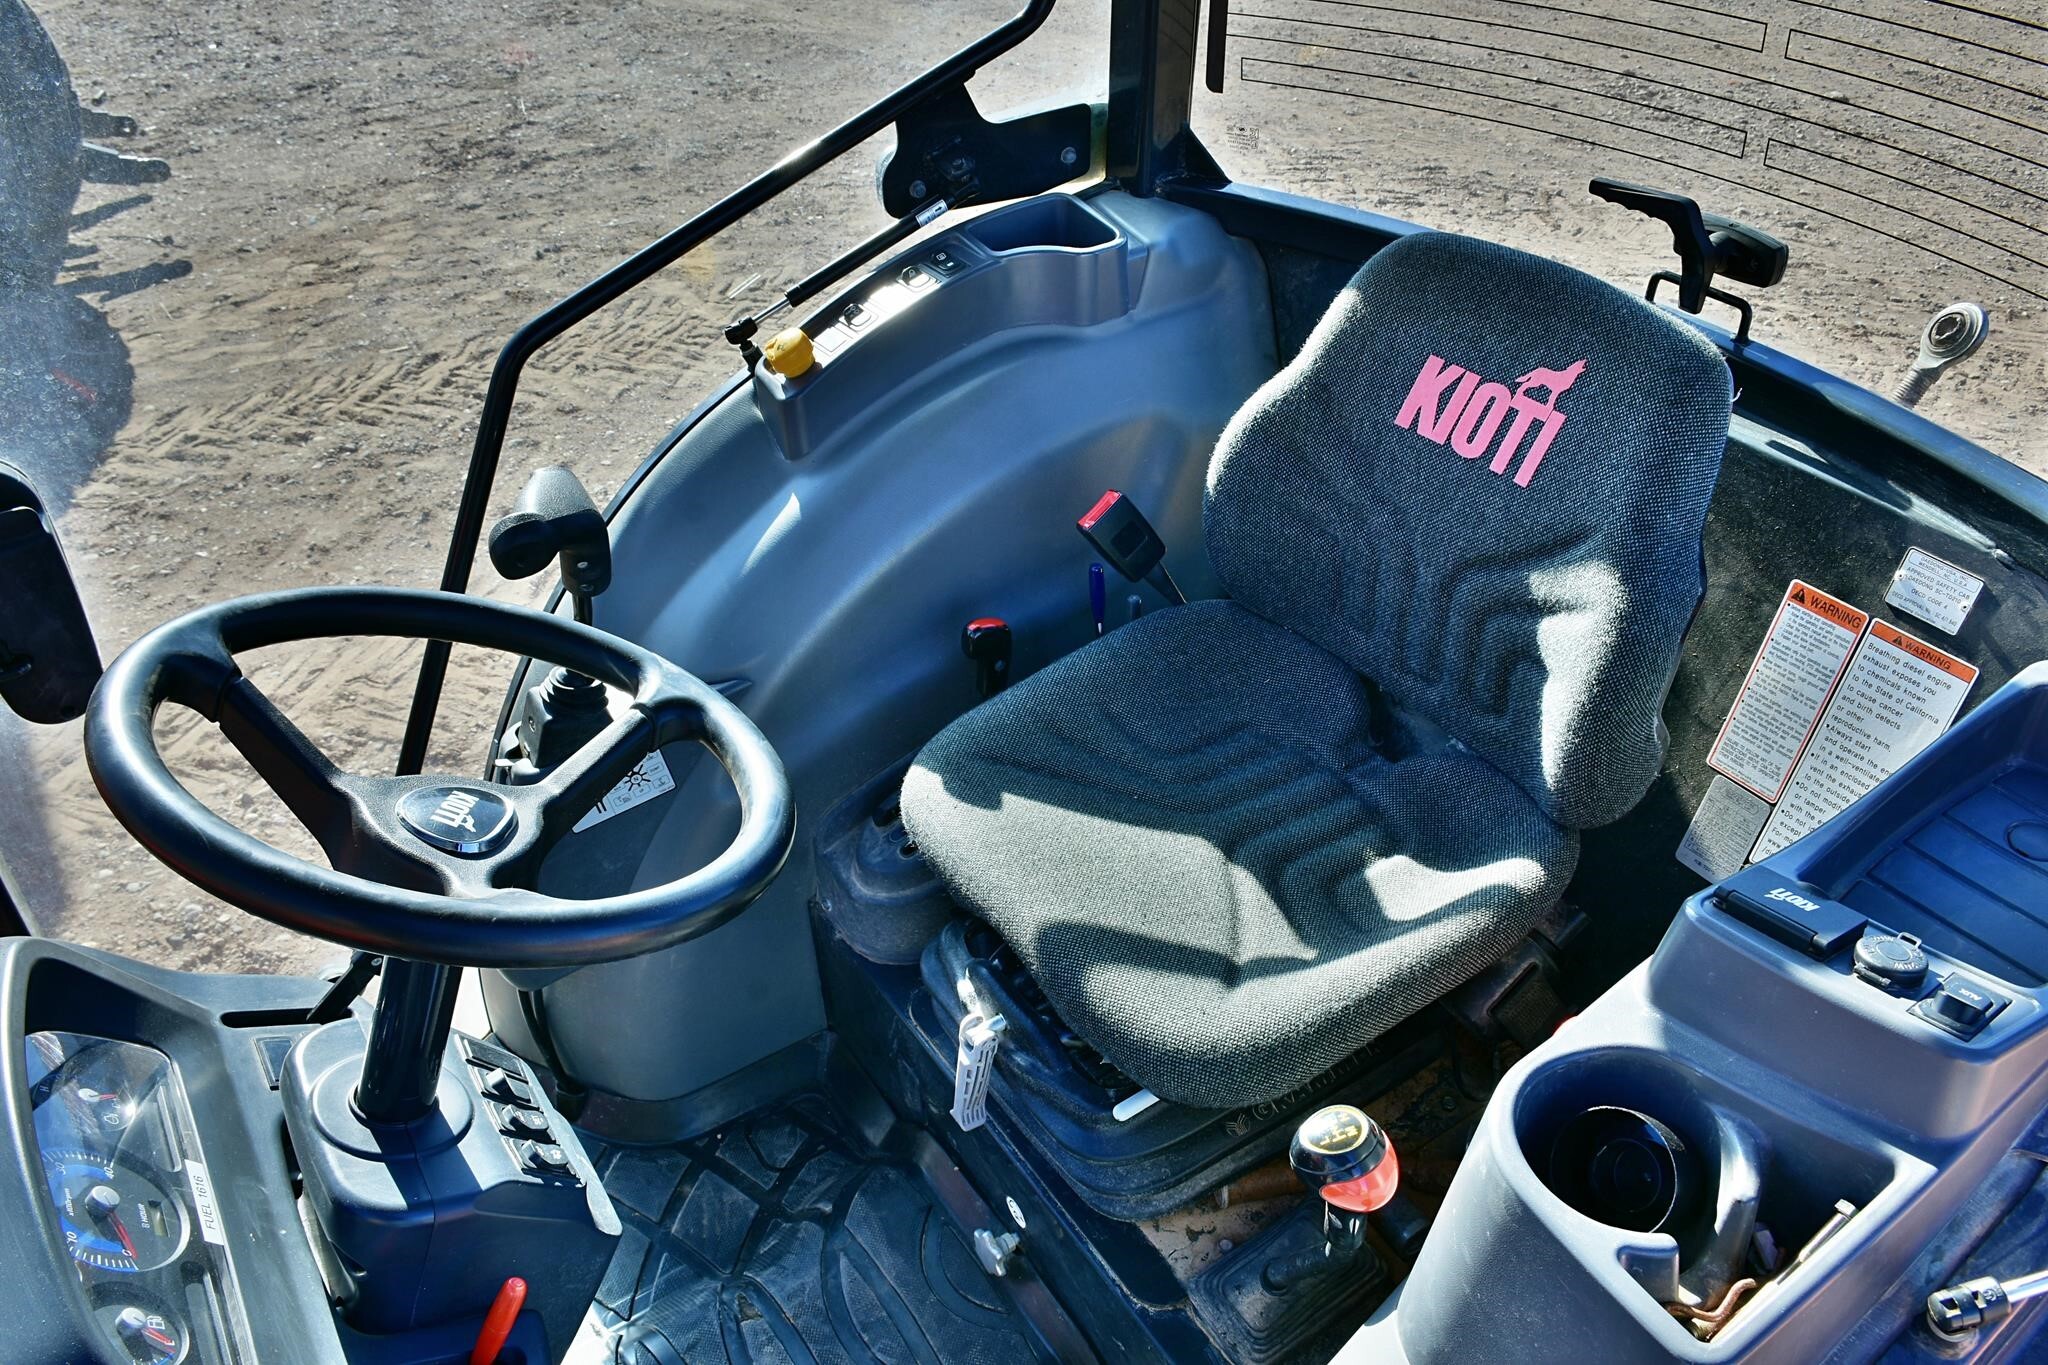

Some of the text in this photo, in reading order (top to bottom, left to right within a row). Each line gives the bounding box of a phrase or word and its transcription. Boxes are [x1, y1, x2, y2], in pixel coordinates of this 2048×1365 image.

[1394, 354, 1568, 488] KIOTI
[1906, 566, 1934, 582] APPROVED
[1935, 580, 1957, 593] SAFETY
[1810, 595, 1861, 628] WARNING
[1867, 642, 1951, 690] Breathing diesel engine
[1905, 642, 1951, 670] WARNING
[1857, 663, 1926, 703] to chemicals known
[1862, 654, 1936, 695] exhaust exposes you
[1841, 694, 1900, 729] and birth defects
[1846, 683, 1903, 717] to cause cancer
[1851, 673, 1938, 724] to the State of California
[1830, 714, 1871, 739] reproductive
[1845, 709, 1864, 722] other
[1824, 735, 1838, 746] and
[1838, 743, 1864, 761] operate
[1866, 758, 1877, 769] the
[1828, 725, 1871, 752] Always start
[1804, 773, 1811, 781] to
[1813, 778, 1824, 788] the
[1809, 764, 1824, 776] vent
[1825, 773, 1836, 783] the
[1829, 763, 1837, 771] an
[1839, 769, 1870, 790] enclosed
[1798, 782, 1808, 791] Do
[1809, 789, 1821, 799] not
[1783, 810, 1793, 819] Do
[1794, 817, 1806, 828] not
[1789, 802, 1815, 820] with the
[1803, 797, 1826, 814] tamper
[1771, 826, 1782, 836] For
[1779, 821, 1801, 837] except
[1958, 987, 1984, 1001] AUX
[104, 1164, 115, 1180] 40
[192, 1175, 217, 1230] FUEL 1616
